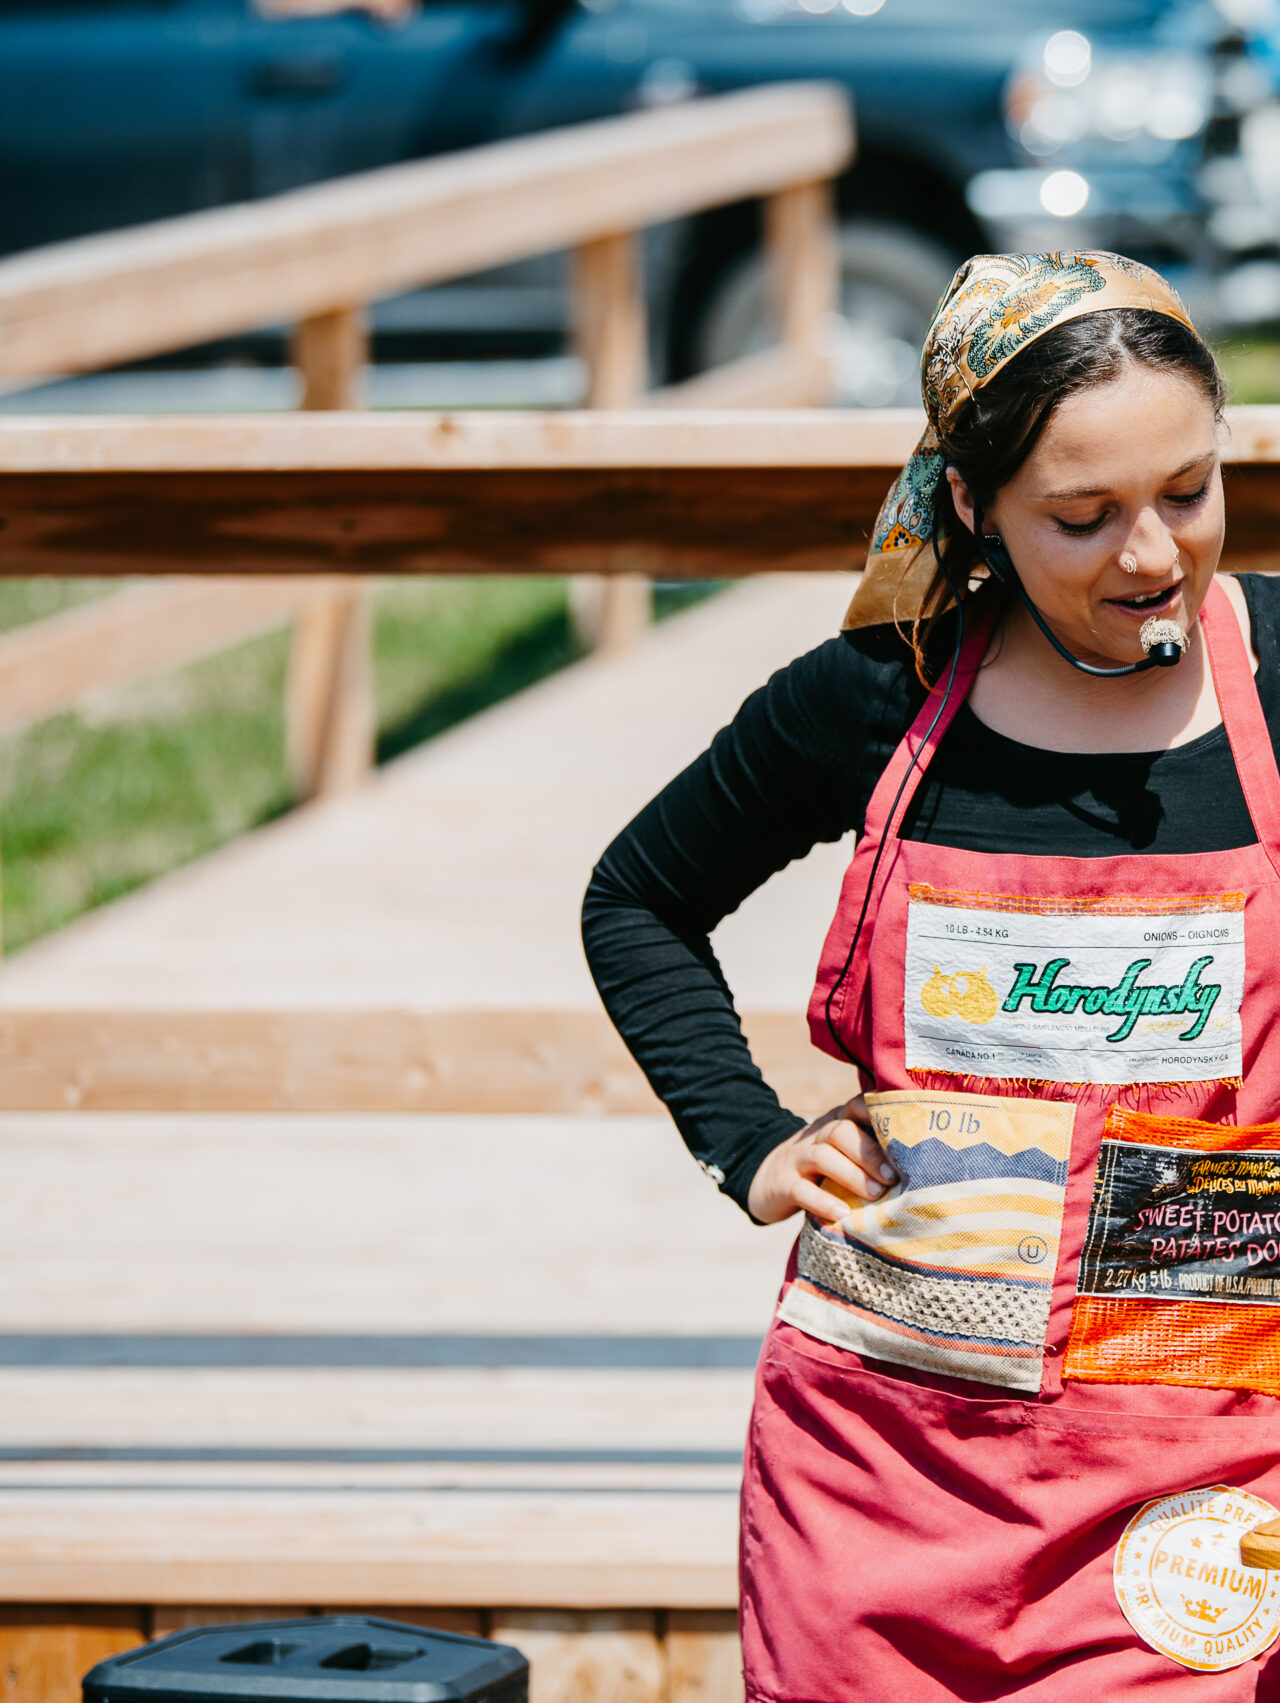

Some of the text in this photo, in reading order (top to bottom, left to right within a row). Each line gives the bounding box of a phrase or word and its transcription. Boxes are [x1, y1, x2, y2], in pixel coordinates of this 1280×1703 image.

[944, 924, 955, 934] 10
[956, 925, 968, 935] LB
[976, 927, 993, 937] 4.54
[995, 929, 1009, 938] KG
[1143, 931, 1178, 942] ONIONS
[1187, 928, 1230, 940] OIGNONS
[1002, 956, 1221, 1042] Horodynsky
[1138, 1018, 1188, 1034] FARMS
[945, 1047, 976, 1060] CANADA
[928, 1109, 952, 1131] 10
[959, 1111, 981, 1134] lb
[1133, 1204, 1206, 1232] SWEET
[1149, 1235, 1241, 1264] PATATES
[1103, 1267, 1130, 1288] 2.27
[1130, 1267, 1147, 1292] kg
[1150, 1270, 1158, 1287] 5
[1159, 1268, 1172, 1289] lb
[1178, 1272, 1216, 1293] PRODUCT
[1215, 1275, 1226, 1293] OF
[1153, 1549, 1263, 1600] PREMIUM
[1203, 1616, 1264, 1658] QUALITY
